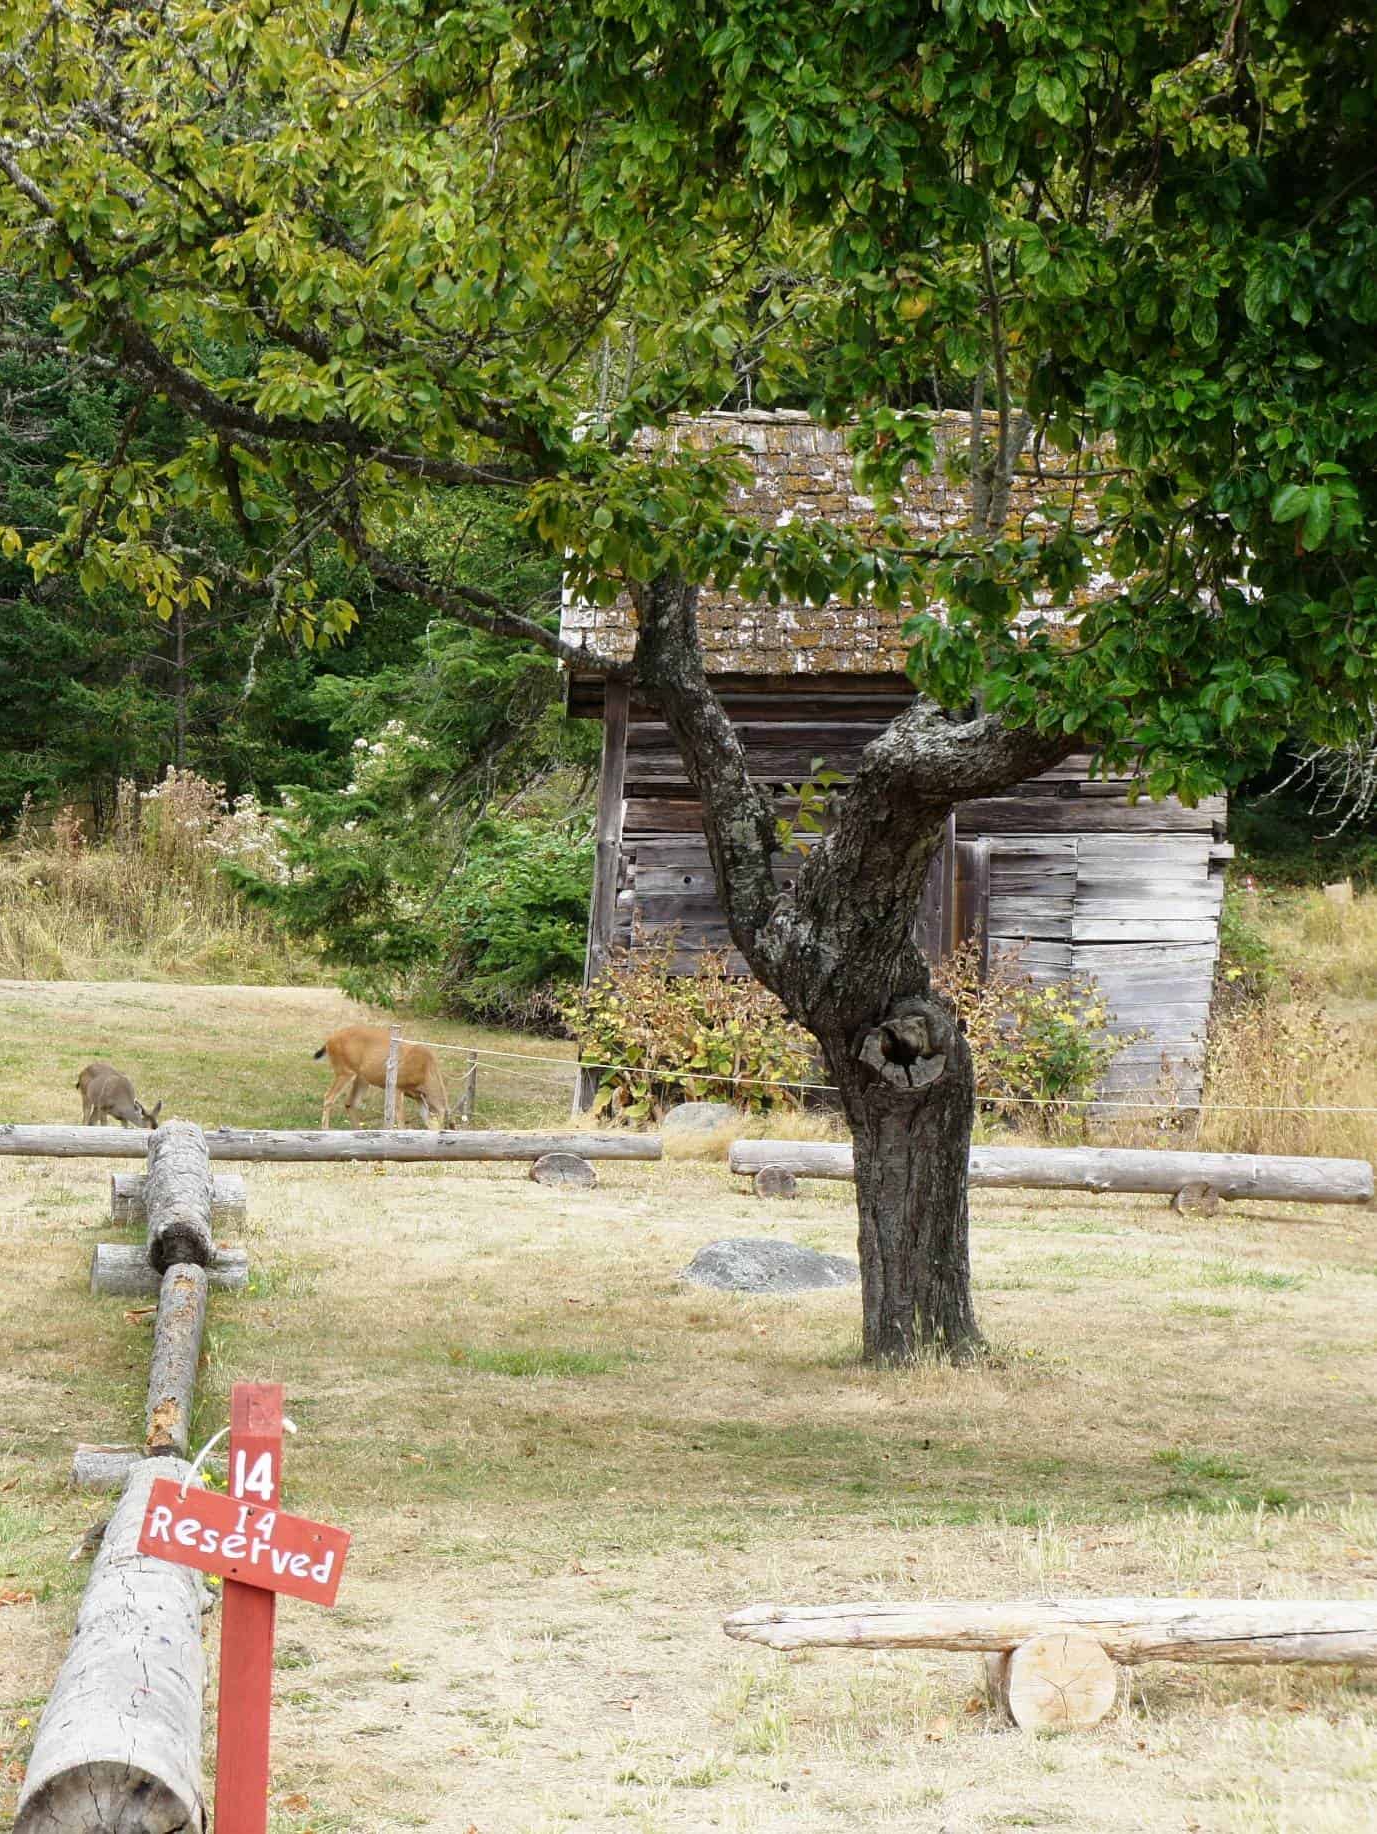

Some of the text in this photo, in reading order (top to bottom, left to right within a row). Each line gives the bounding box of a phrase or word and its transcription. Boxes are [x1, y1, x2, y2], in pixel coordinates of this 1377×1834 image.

[235, 1450, 274, 1500] 14
[149, 1506, 334, 1583] Reserved
[235, 1506, 276, 1540] 14
